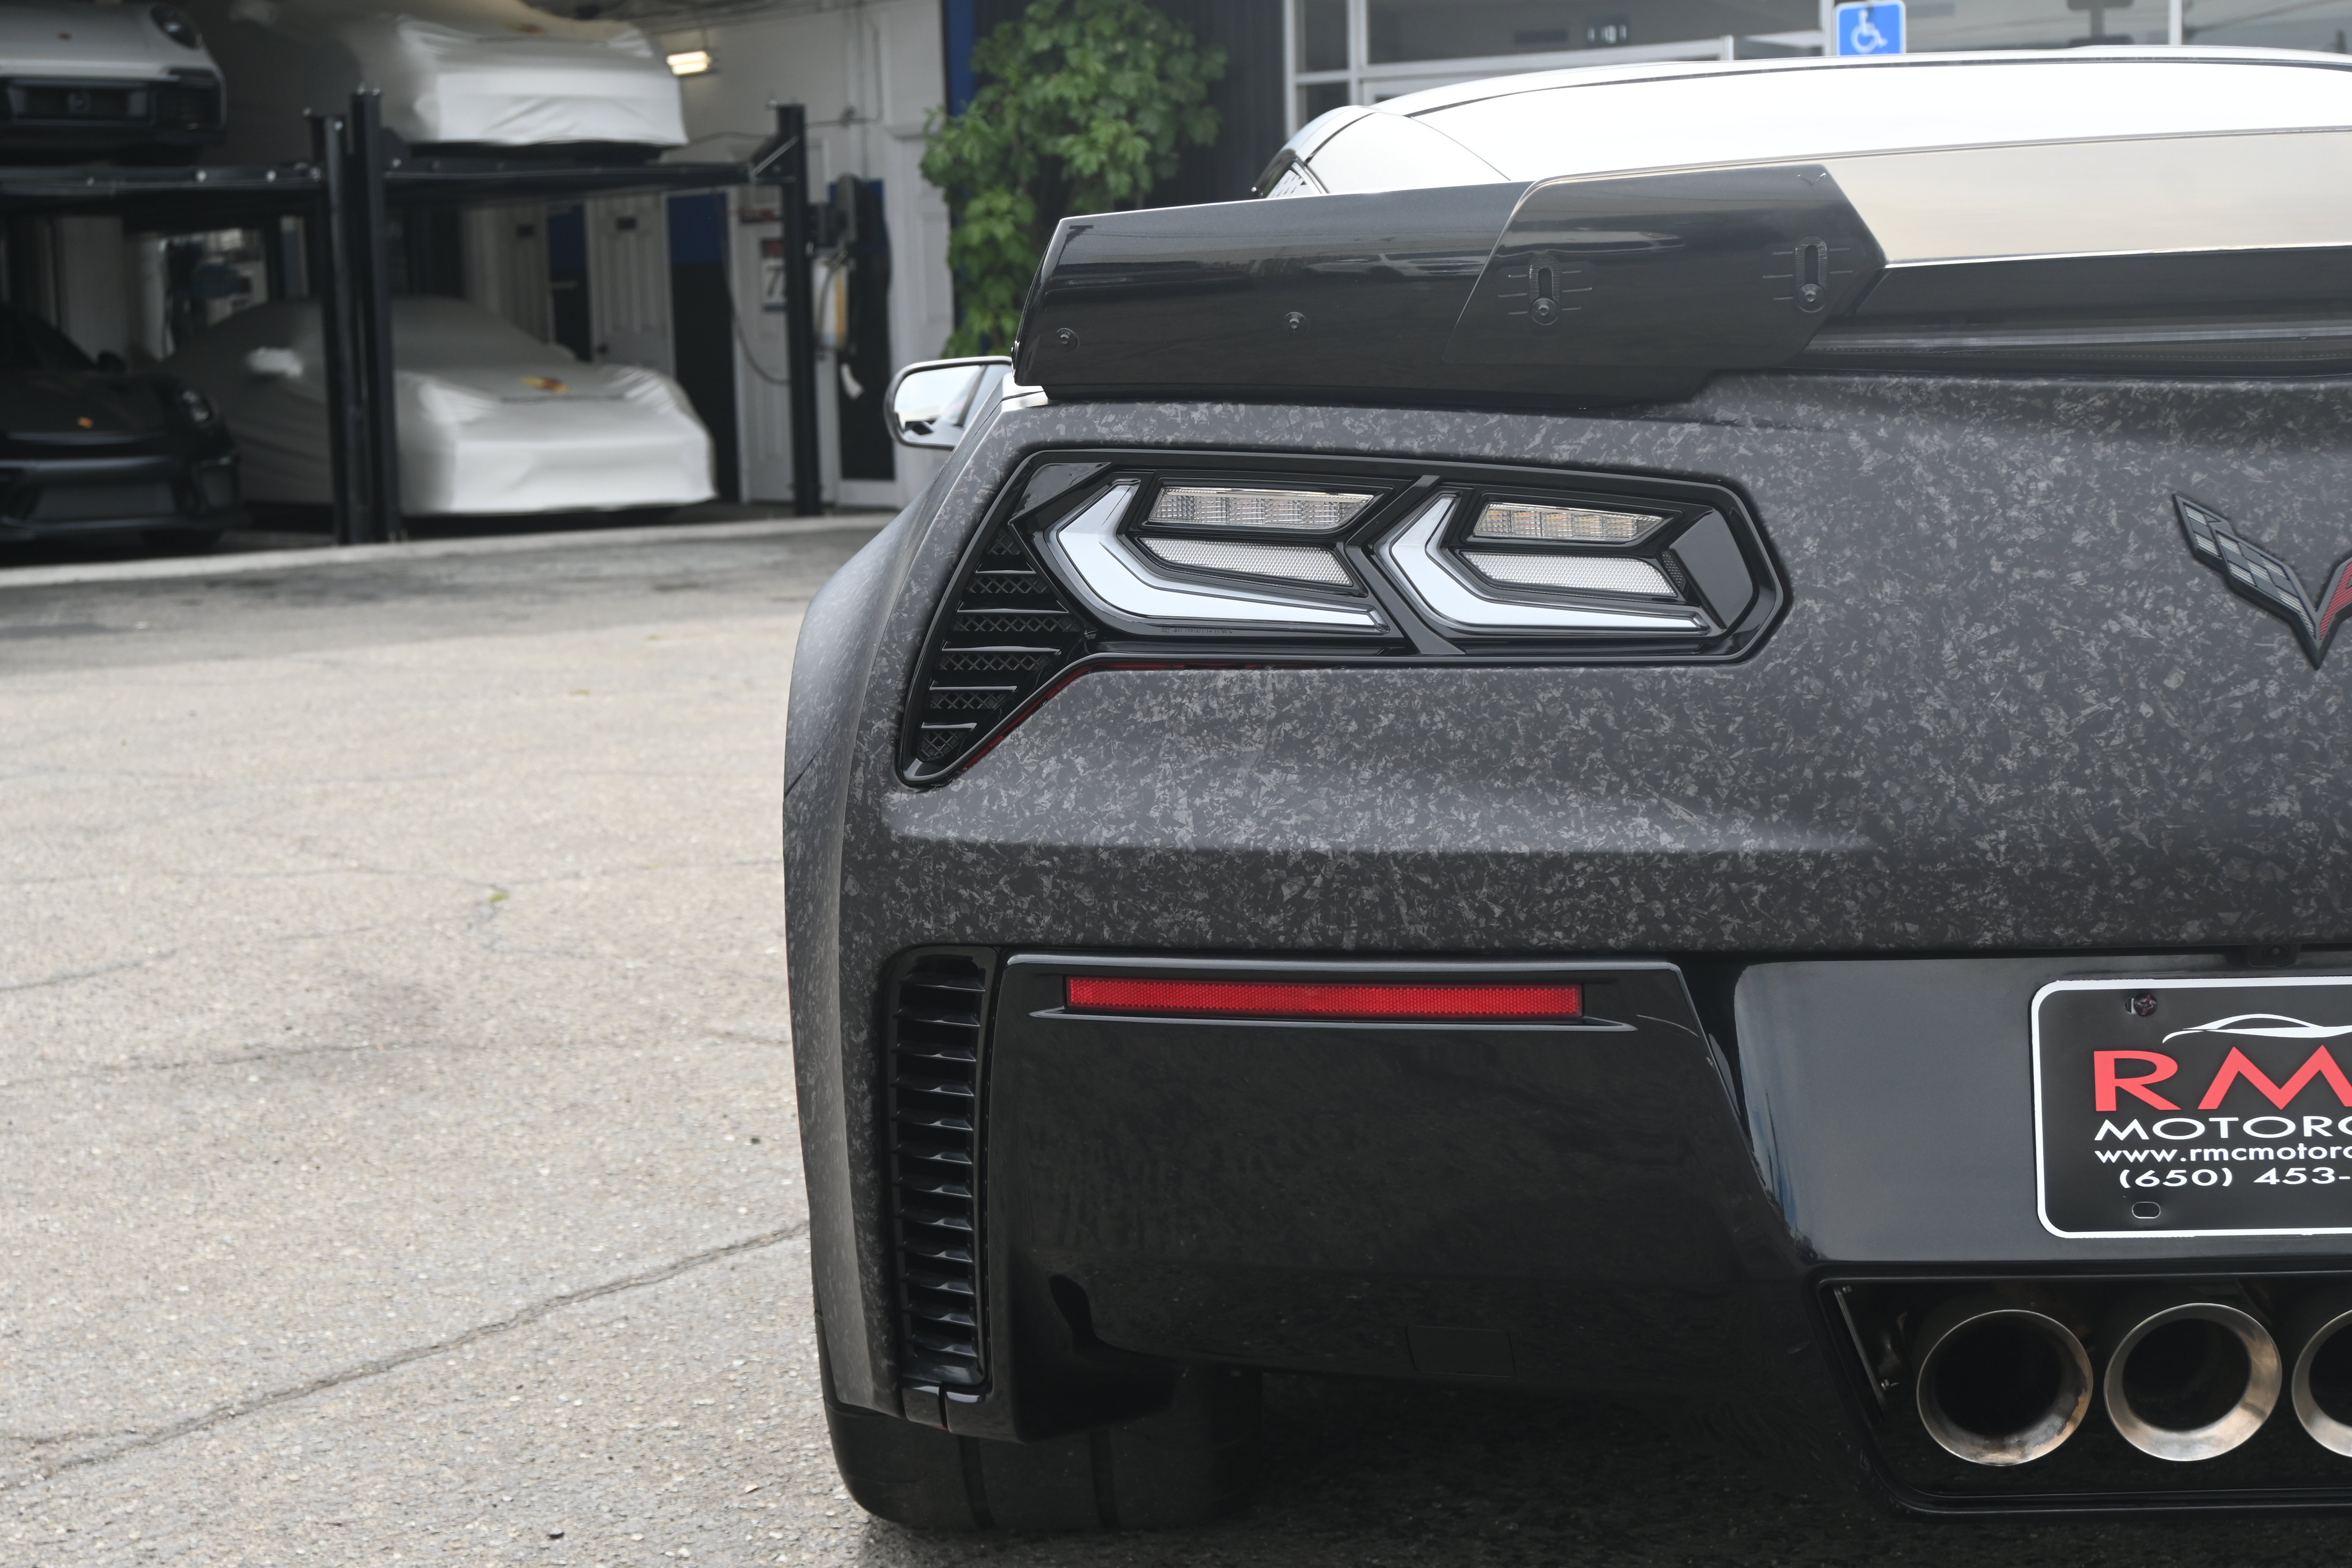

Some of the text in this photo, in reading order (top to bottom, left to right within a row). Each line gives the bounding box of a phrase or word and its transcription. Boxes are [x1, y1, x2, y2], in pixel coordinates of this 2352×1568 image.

[2094, 1045, 2352, 1112] RM
[2119, 1167, 2351, 1188] (650) 453-
